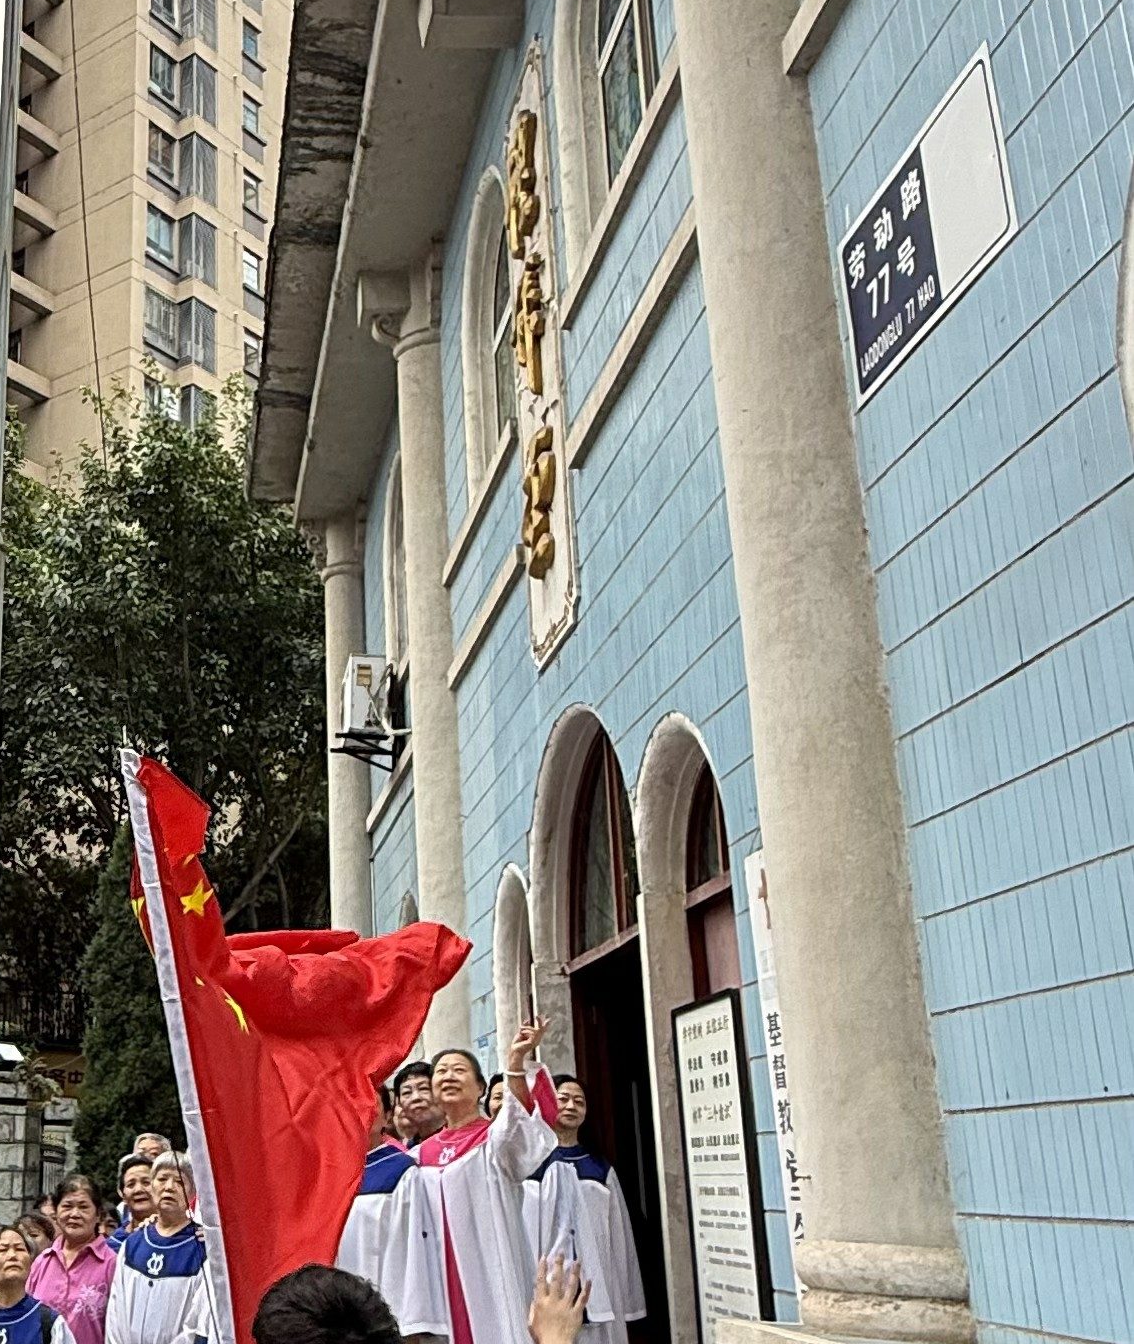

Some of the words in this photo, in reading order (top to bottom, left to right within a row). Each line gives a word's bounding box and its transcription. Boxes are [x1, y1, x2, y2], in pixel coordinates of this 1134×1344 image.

[847, 168, 922, 290] 劳动路
[866, 235, 916, 319] 77号
[860, 312, 904, 378] LAODONGLU
[905, 297, 916, 324] 77
[917, 274, 936, 311] HAO
